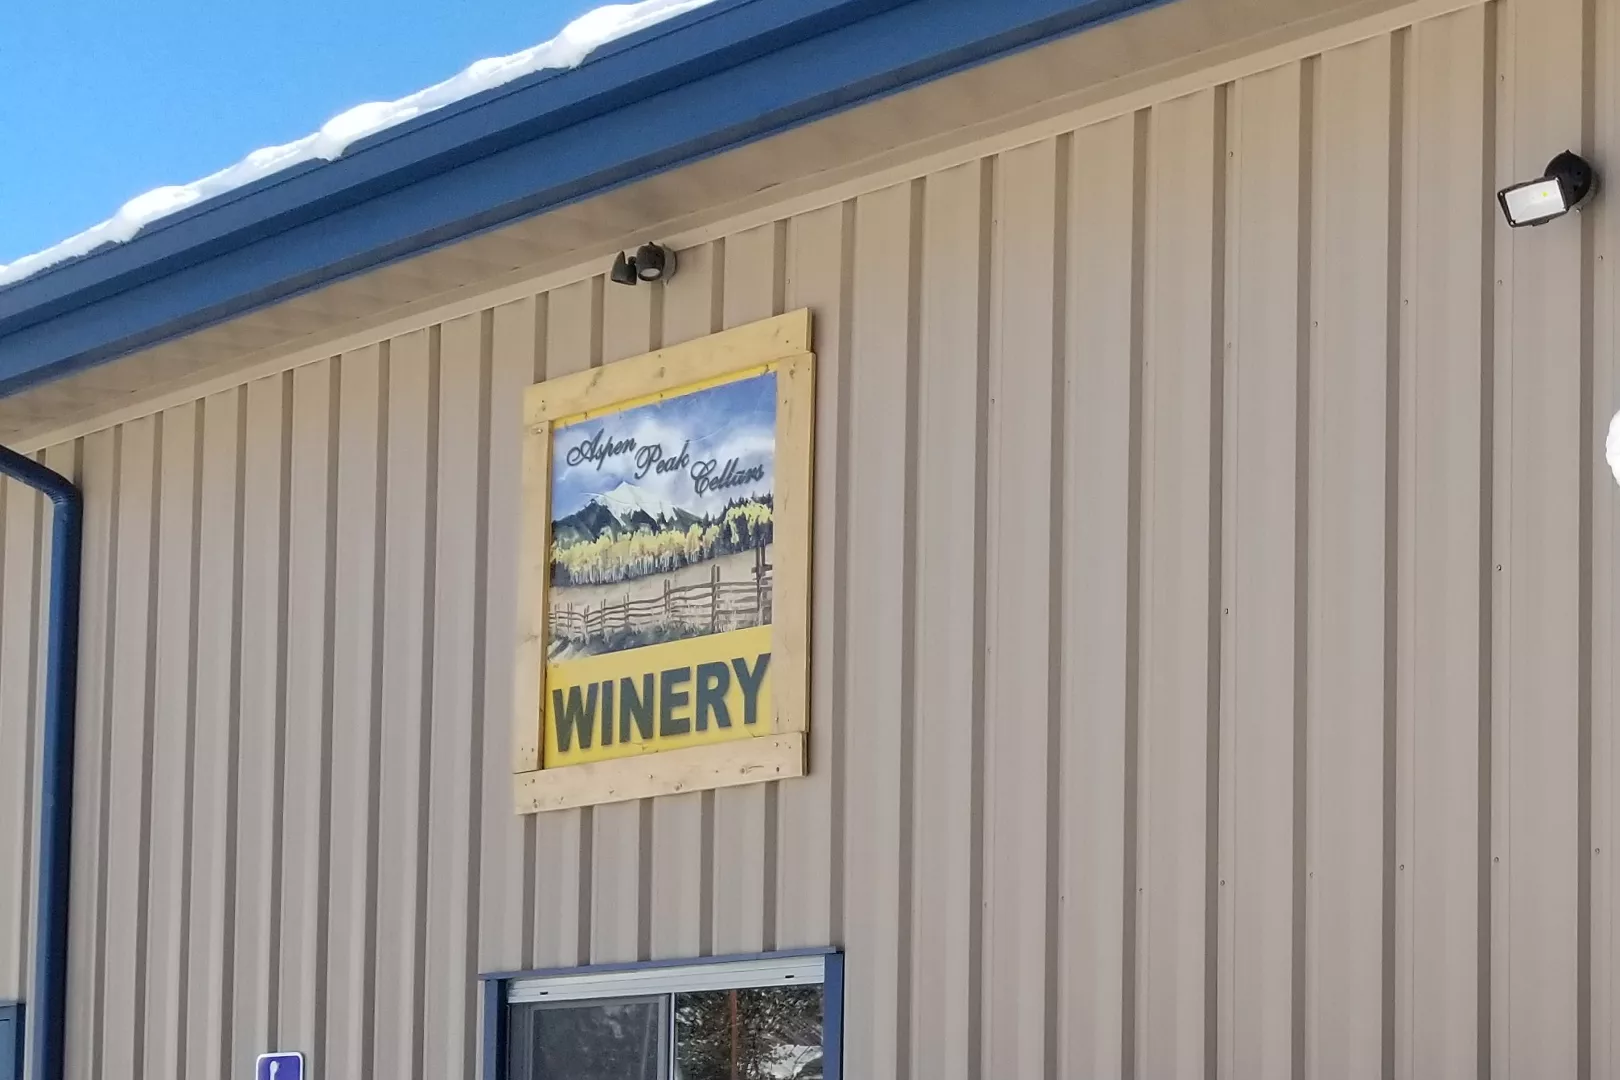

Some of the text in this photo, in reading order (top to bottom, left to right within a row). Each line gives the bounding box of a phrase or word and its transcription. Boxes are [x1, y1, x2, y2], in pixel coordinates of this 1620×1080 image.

[566, 428, 765, 497] Aspen Peak Cellars
[552, 652, 772, 753] WINERY
